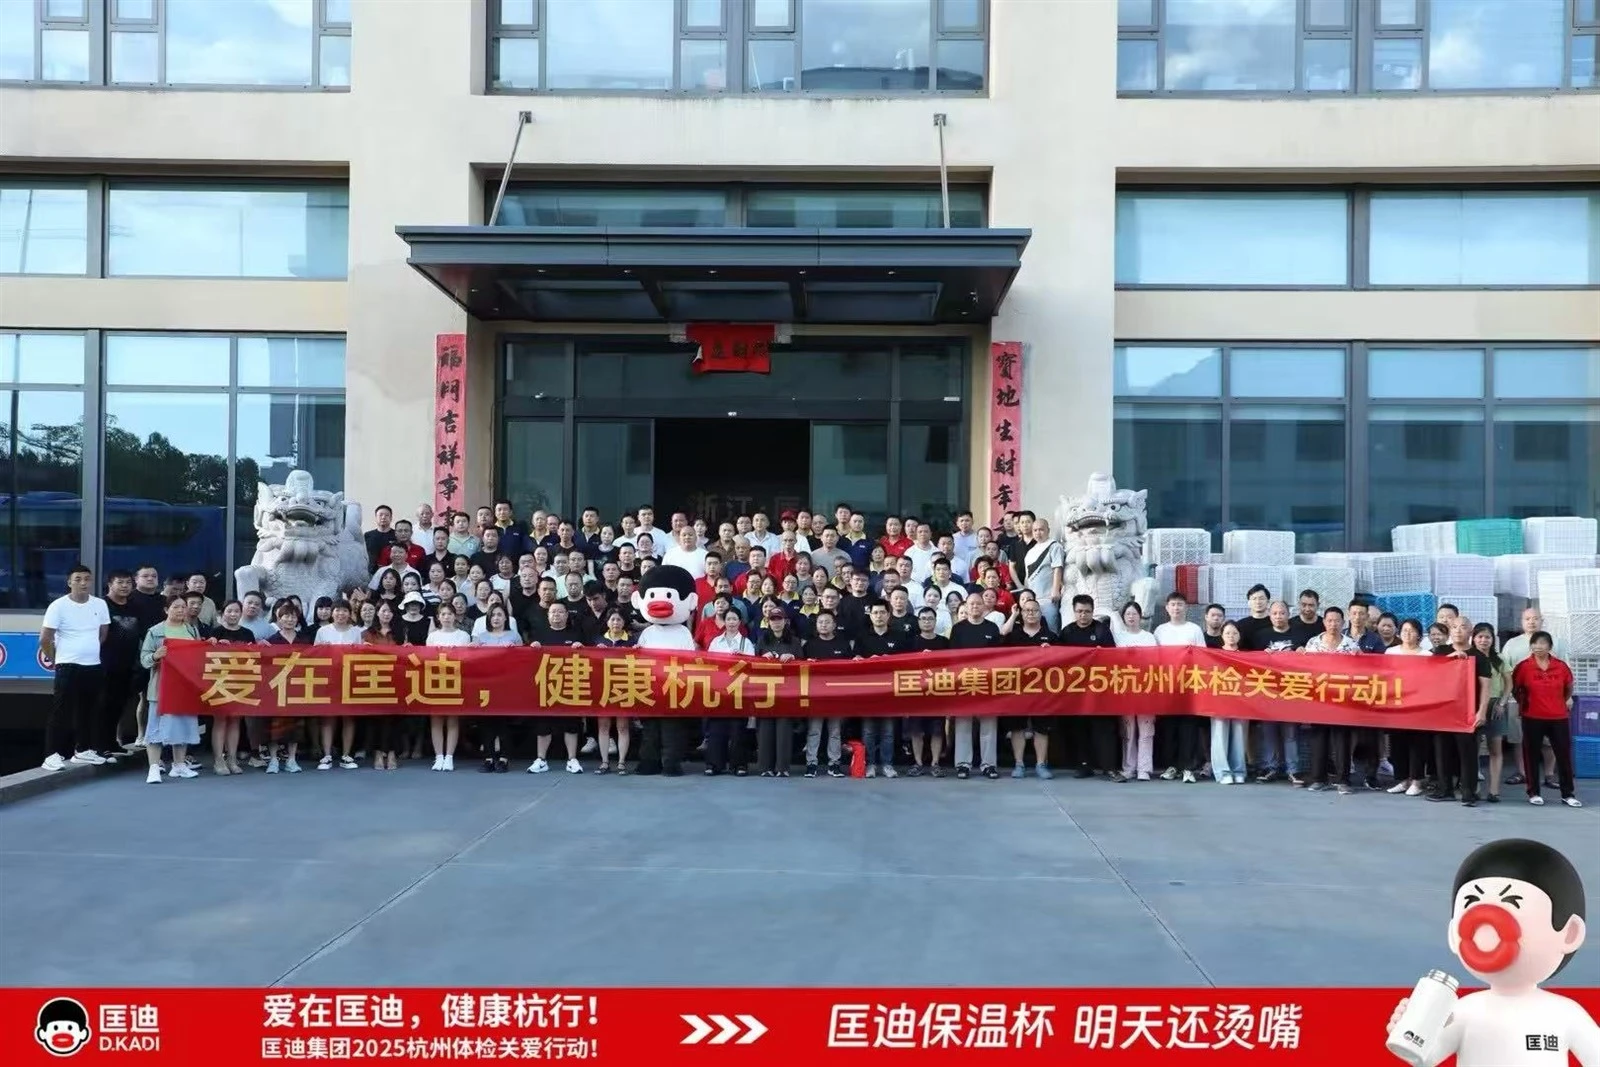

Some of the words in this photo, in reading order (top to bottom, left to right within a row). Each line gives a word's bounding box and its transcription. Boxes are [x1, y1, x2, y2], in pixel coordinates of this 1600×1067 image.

[200, 651, 810, 708] 爱在匡迪，健康杭行！
